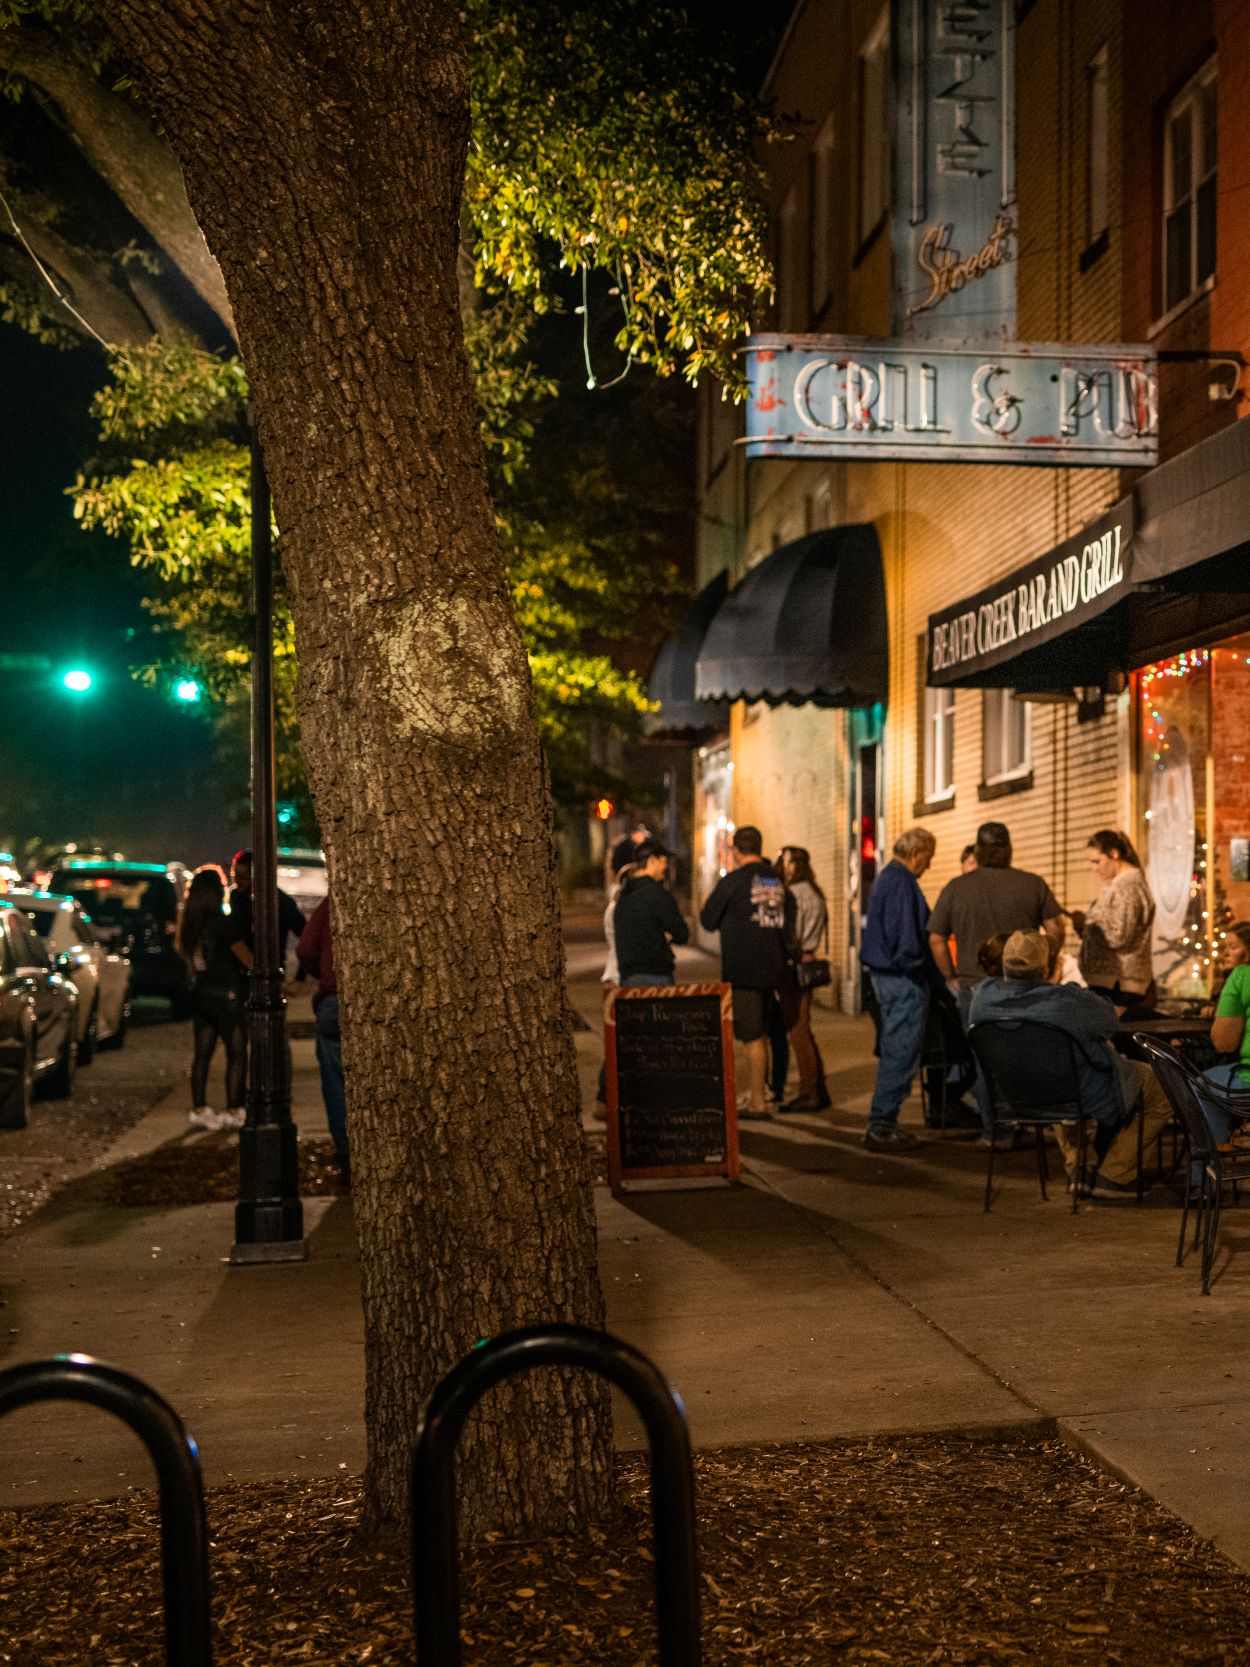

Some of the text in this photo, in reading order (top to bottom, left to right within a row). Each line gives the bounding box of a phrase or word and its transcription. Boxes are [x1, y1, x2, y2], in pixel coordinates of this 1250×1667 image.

[906, 215, 1010, 317] Street
[793, 358, 951, 433] GRILL
[970, 363, 1022, 436] &
[932, 525, 1123, 672] BEAVER CREEK BAR AND GRILL
